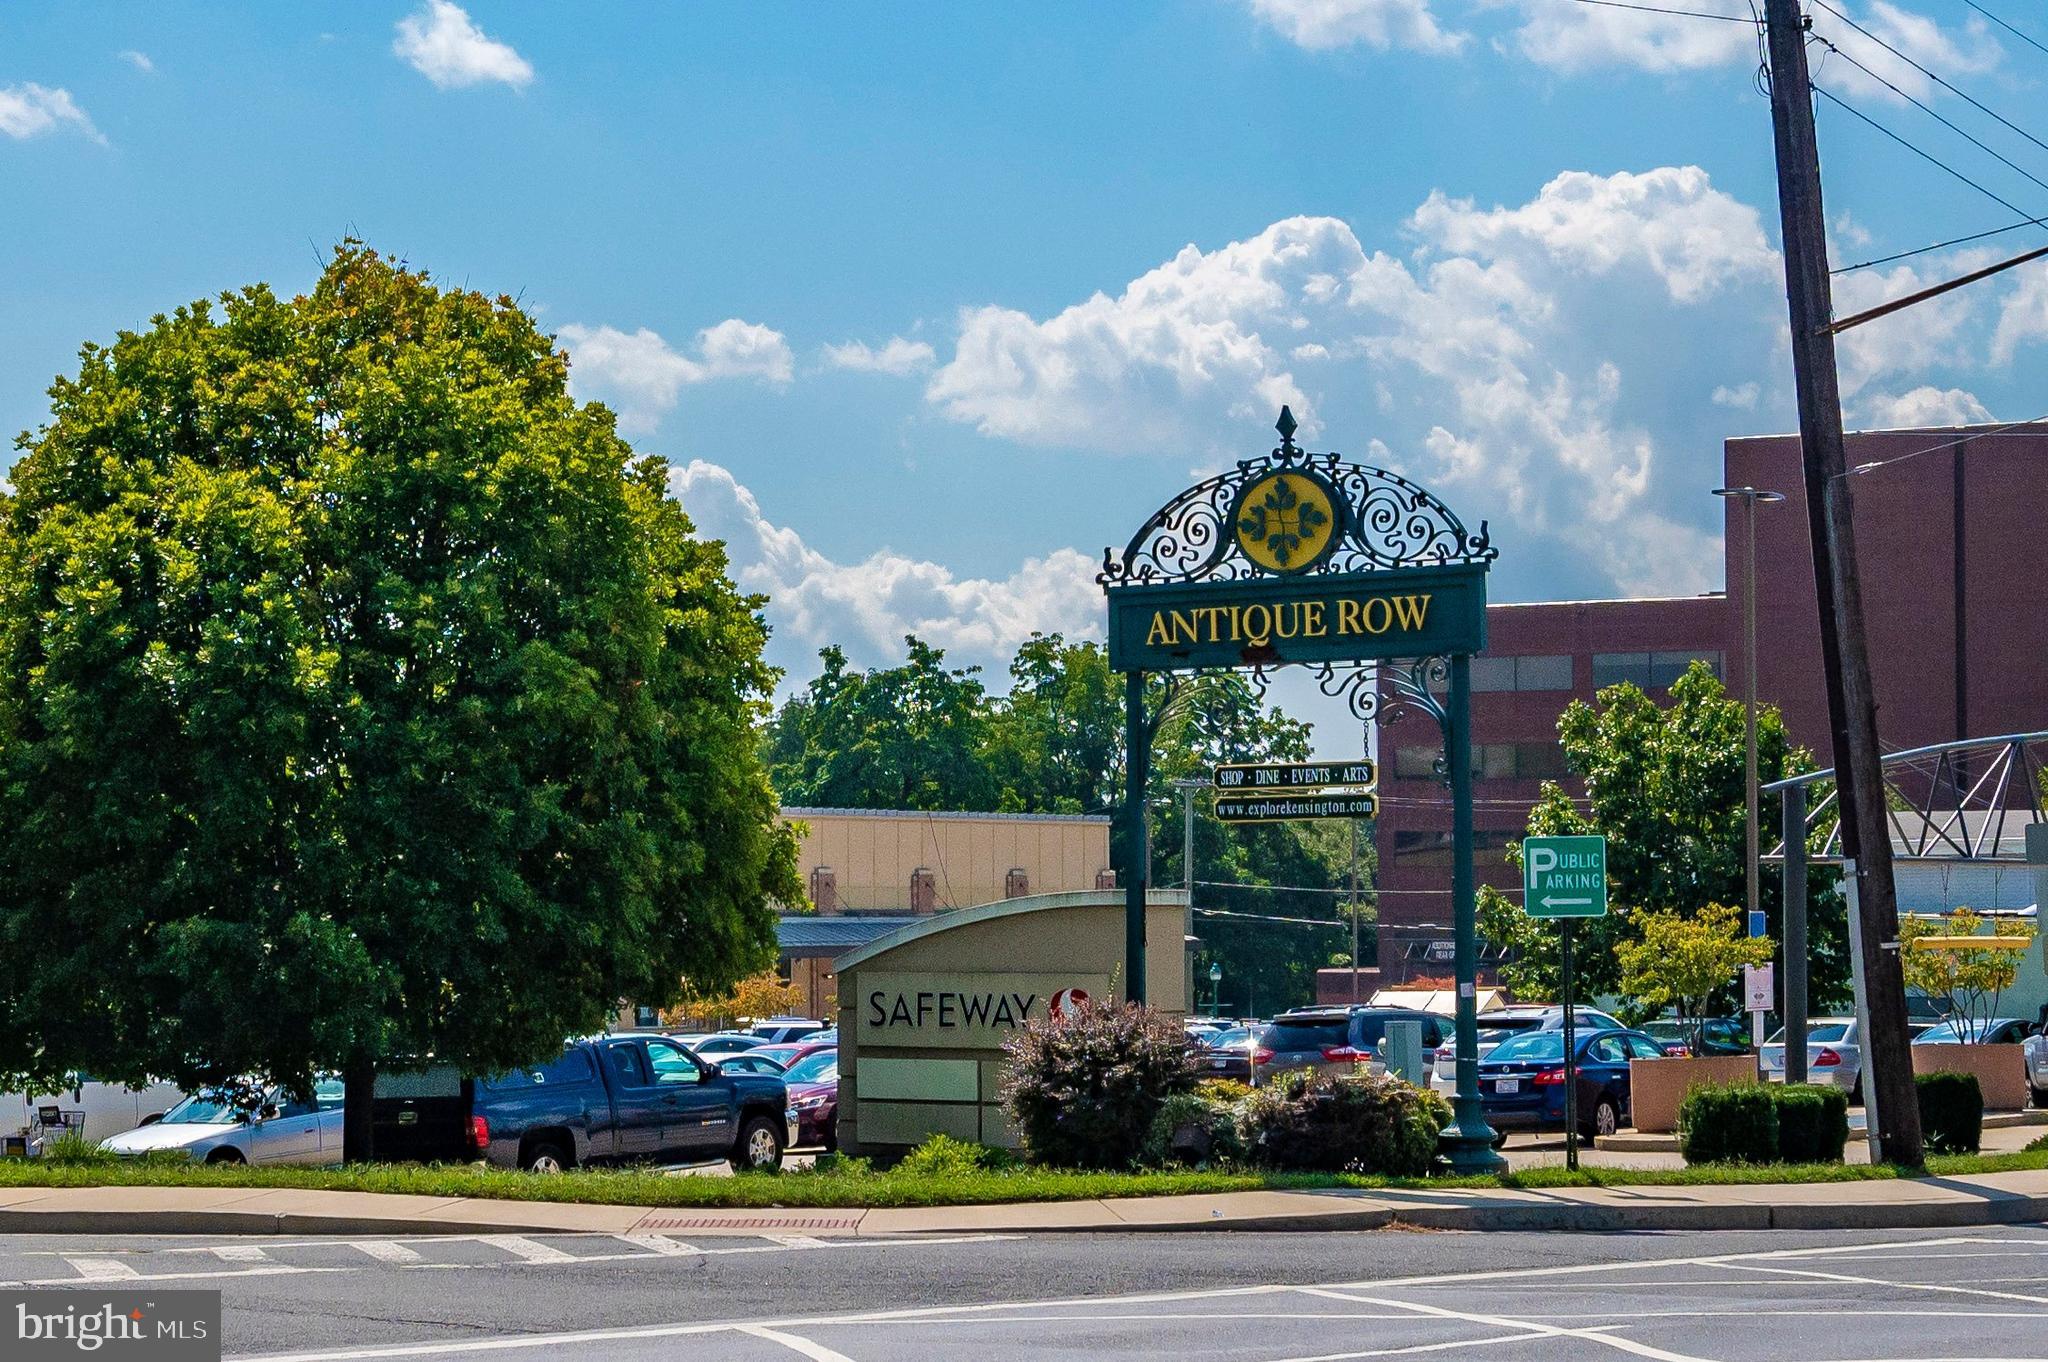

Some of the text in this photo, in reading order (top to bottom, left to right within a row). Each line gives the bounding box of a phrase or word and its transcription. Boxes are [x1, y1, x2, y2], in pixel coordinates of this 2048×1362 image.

[1146, 594, 1432, 647] ANTIQUE ROW
[1220, 766, 1369, 786] SHOP DINE EVENTS ARTS
[1217, 799, 1373, 819] www.explorekensington.com
[869, 990, 1037, 1029] SAFEWAY
